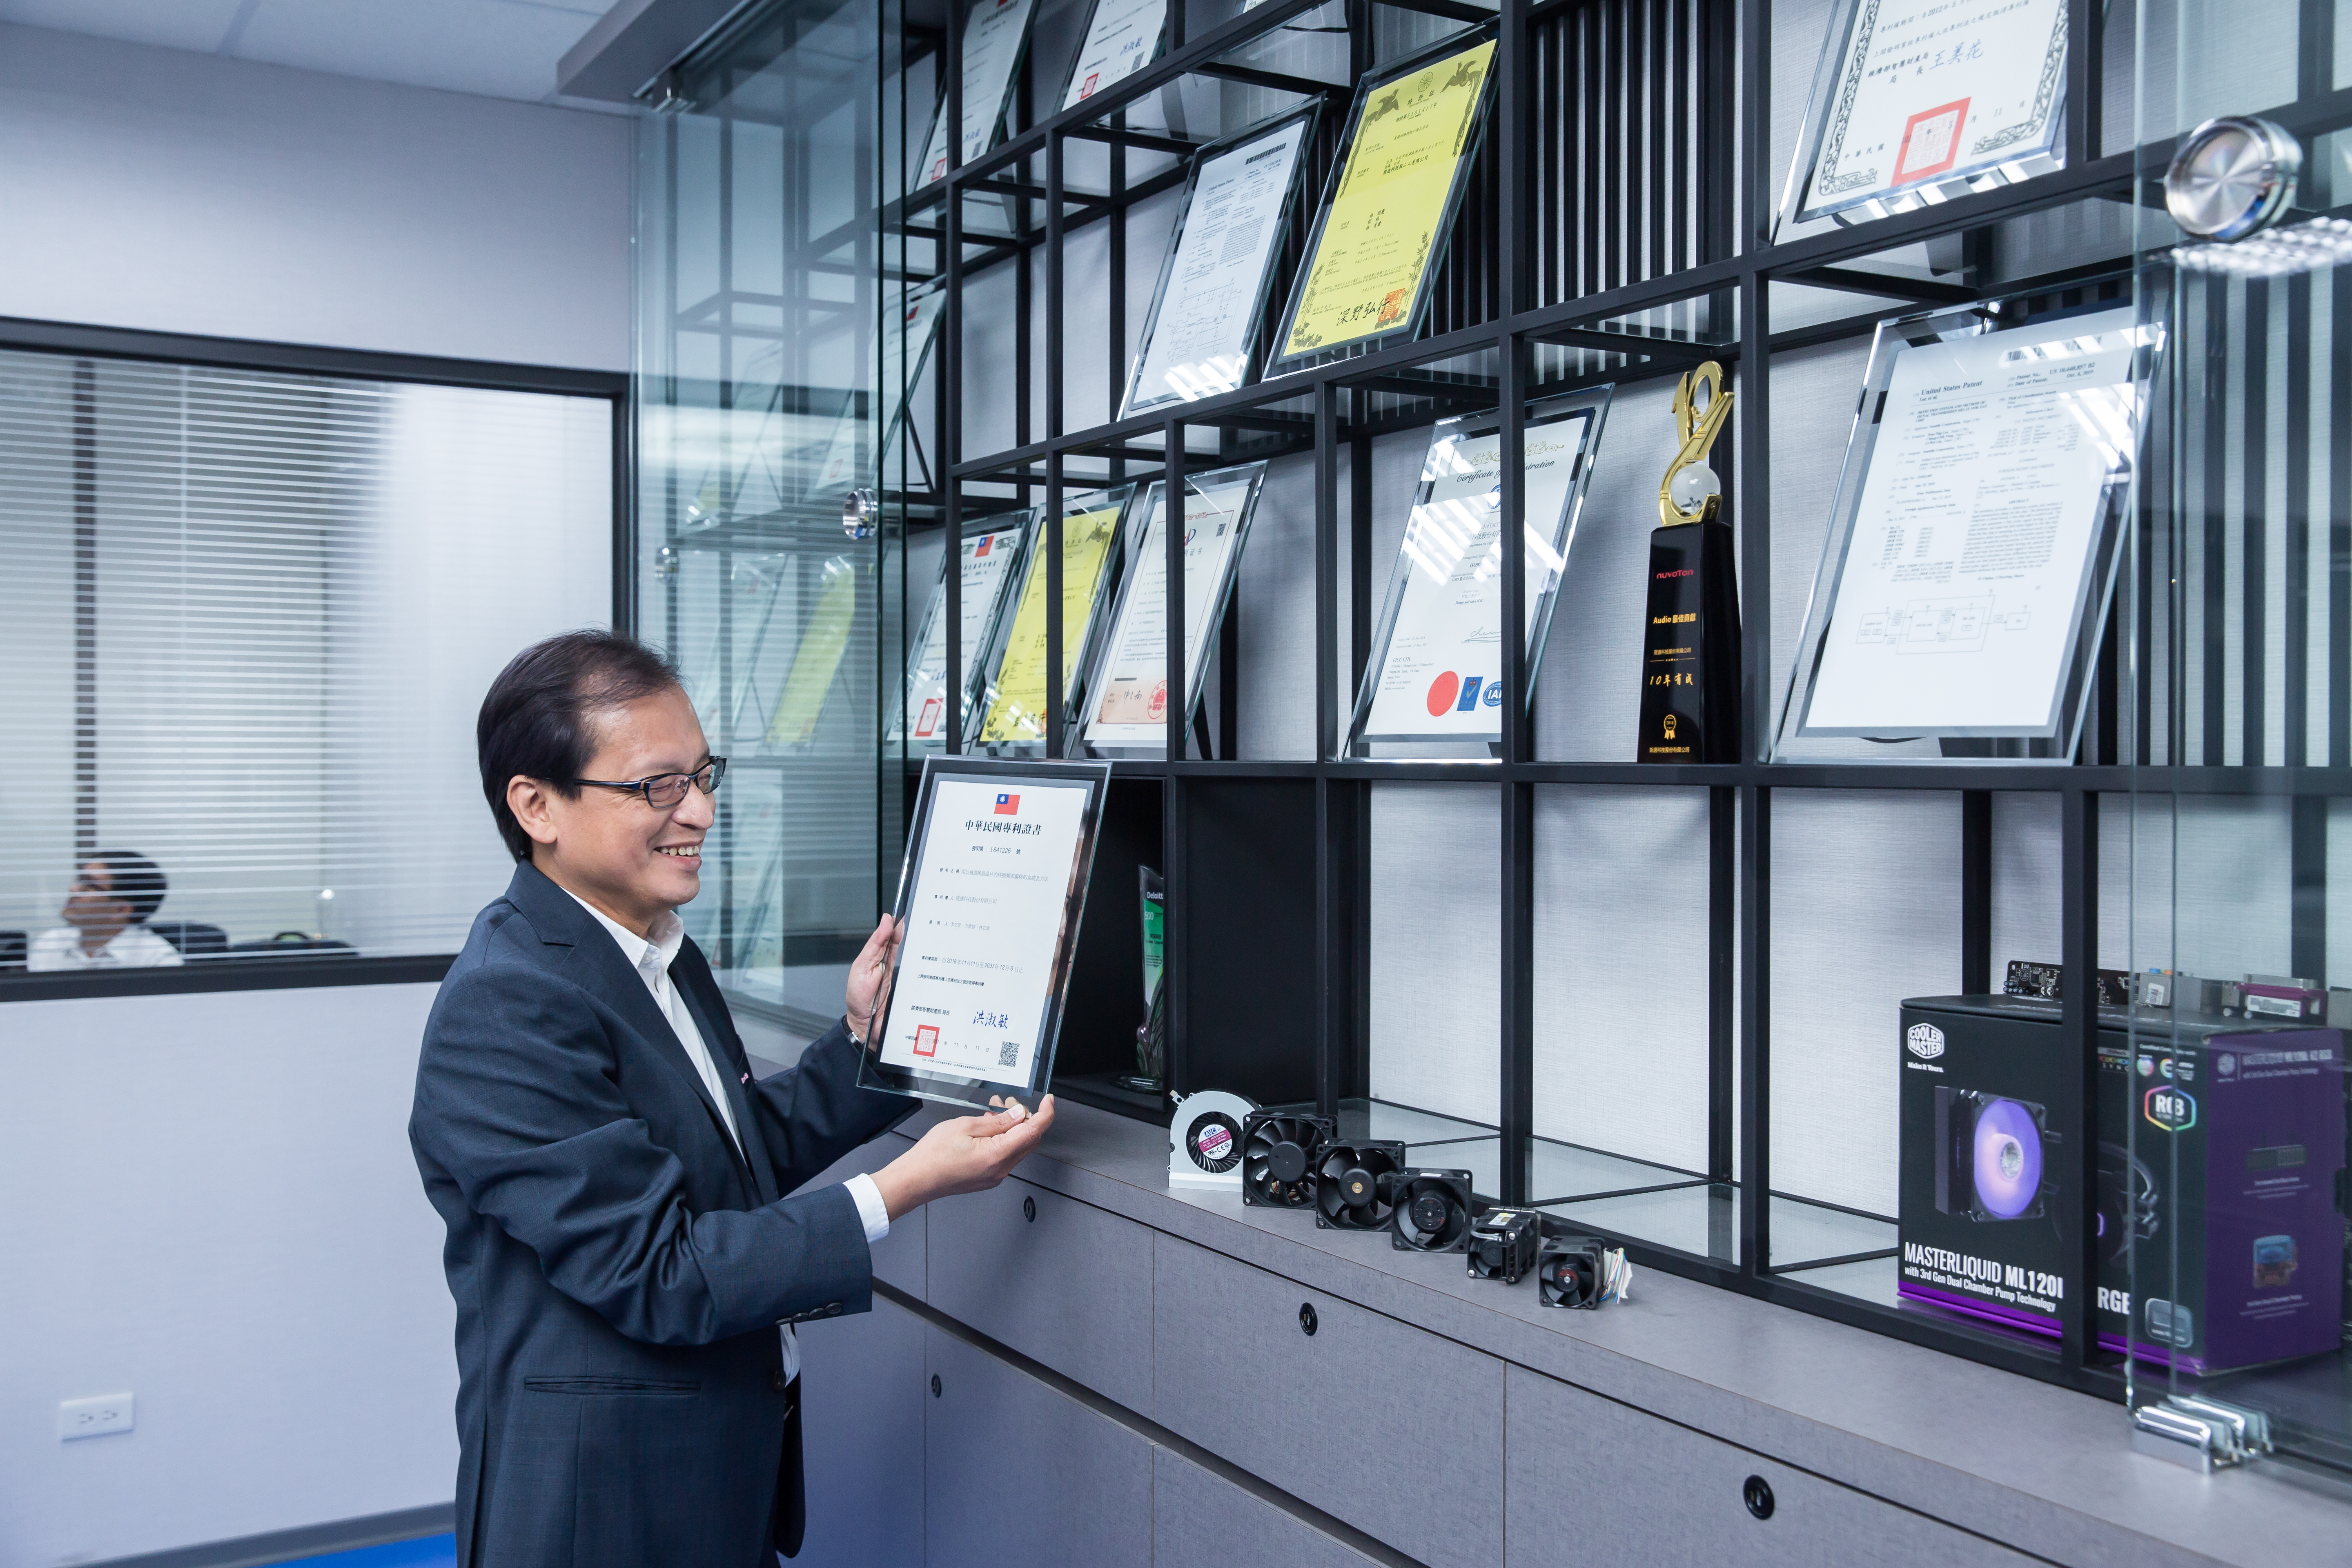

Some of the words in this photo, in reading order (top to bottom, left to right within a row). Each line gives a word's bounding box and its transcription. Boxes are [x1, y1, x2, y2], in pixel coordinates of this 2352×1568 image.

[1867, 51, 1929, 78] 經濟部智慧財產局
[1844, 143, 1884, 161] 中華民國
[1921, 385, 1941, 396] United
[1942, 383, 1961, 392] States
[1962, 380, 1983, 389] Patent
[1457, 470, 1494, 483] Certificate
[1524, 459, 1555, 471] istration
[1653, 615, 1672, 624] Audio
[1673, 613, 1696, 623] 最佳貢獻
[965, 820, 1042, 835] 中華民國專利證書
[1147, 891, 1163, 900] Deloitt
[973, 1010, 1009, 1029] 洪淑敏
[1910, 1026, 1942, 1043] COOLER
[1910, 1039, 1942, 1056] MASTER
[1907, 1062, 1922, 1070] Make
[1205, 1128, 1216, 1137] AVC
[1904, 1242, 2002, 1283] MASTERLIQUID
[1904, 1265, 1919, 1278] with
[1920, 1267, 1931, 1280] 3rd
[1932, 1271, 1947, 1285] Gen
[1947, 1274, 1963, 1288] Dual
[1963, 1279, 1994, 1296] Chamber
[1995, 1286, 2015, 1303] Pump
[2016, 1290, 2057, 1312] Technology
